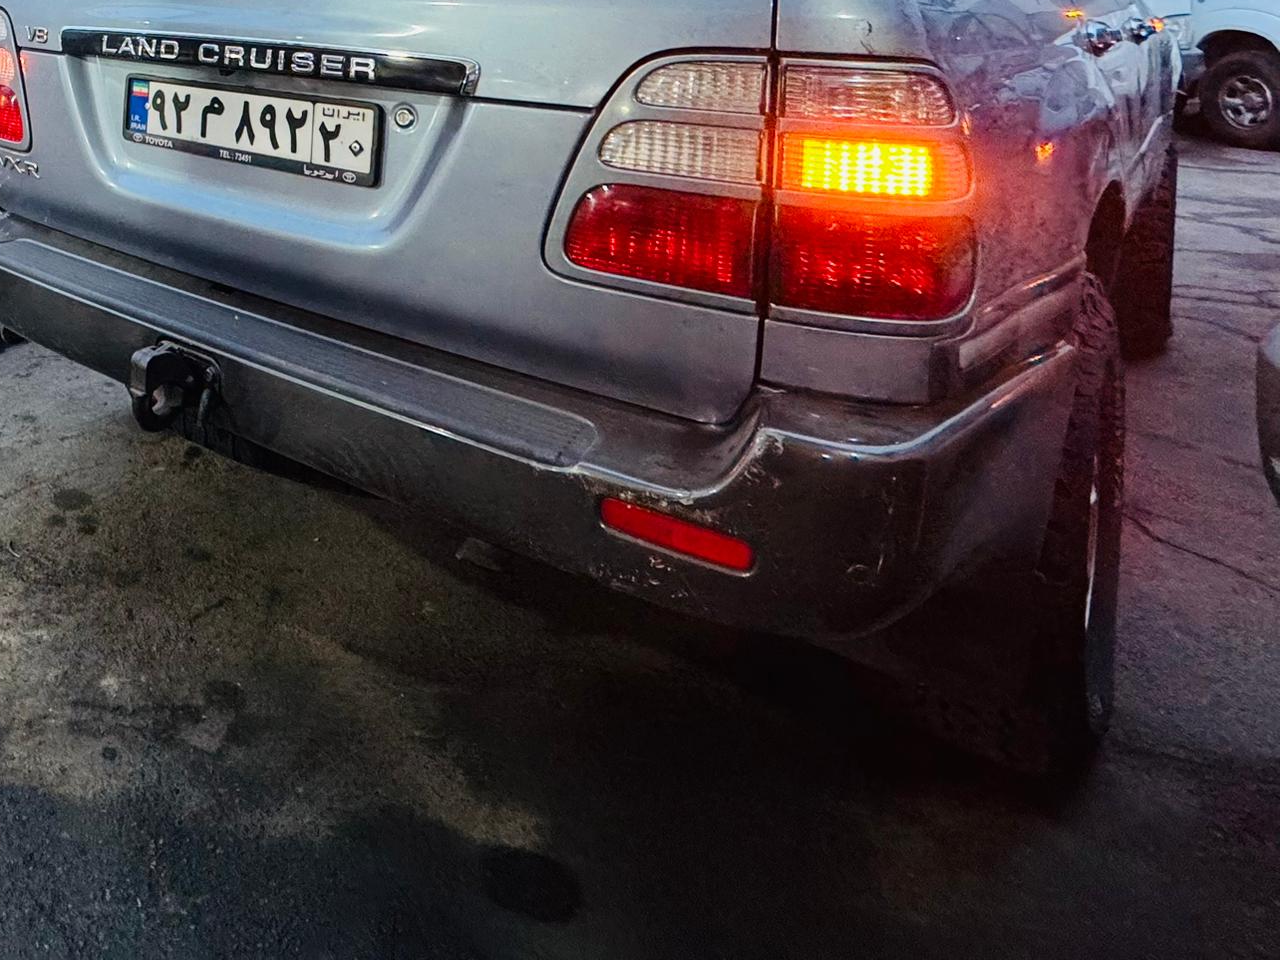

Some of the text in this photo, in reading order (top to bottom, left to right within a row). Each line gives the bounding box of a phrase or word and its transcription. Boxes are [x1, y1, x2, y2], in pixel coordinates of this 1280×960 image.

[25, 25, 48, 44] V8
[101, 34, 376, 80] LAND CRUISER
[323, 106, 366, 123] ایران
[130, 122, 146, 131] IRAN
[145, 135, 173, 149] TOYOTA
